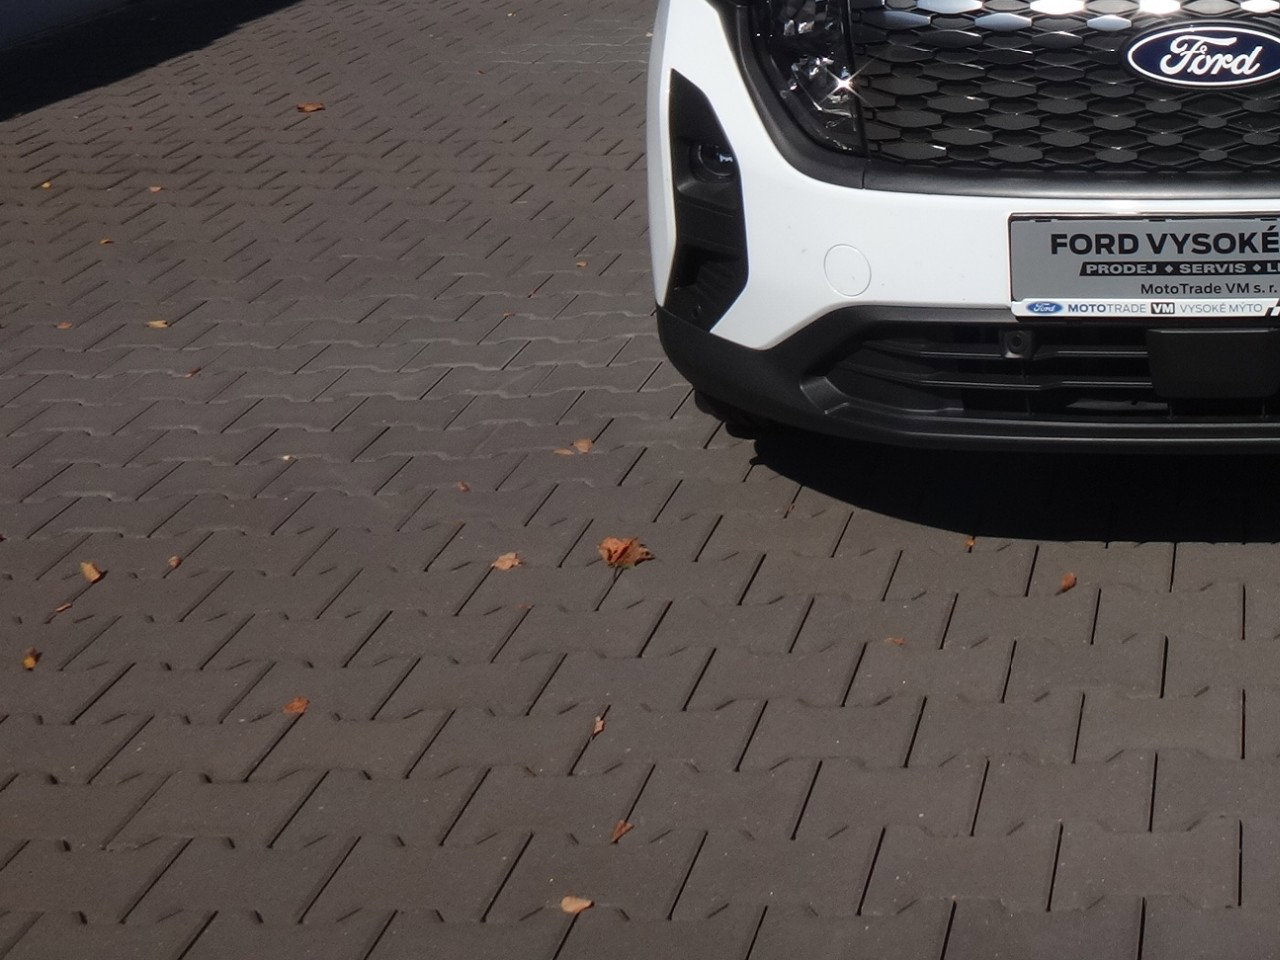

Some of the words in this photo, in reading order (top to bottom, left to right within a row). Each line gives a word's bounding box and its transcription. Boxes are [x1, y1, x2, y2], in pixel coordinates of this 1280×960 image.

[1160, 35, 1263, 75] Ford
[1051, 233, 1139, 255] FORD
[1146, 225, 1280, 255] VYSOKÉ
[1086, 263, 1157, 274] PRODEJ
[1179, 263, 1246, 274] SERVIS
[1140, 283, 1222, 294] MotoTrade
[1225, 283, 1250, 293] VM
[1253, 284, 1265, 293] s.
[1269, 284, 1278, 293] r.
[1068, 303, 1146, 313] MOTOTRADE
[1152, 303, 1174, 313] VM
[1180, 302, 1226, 313] VYSOKÉ
[1229, 301, 1263, 313] MÝTO
